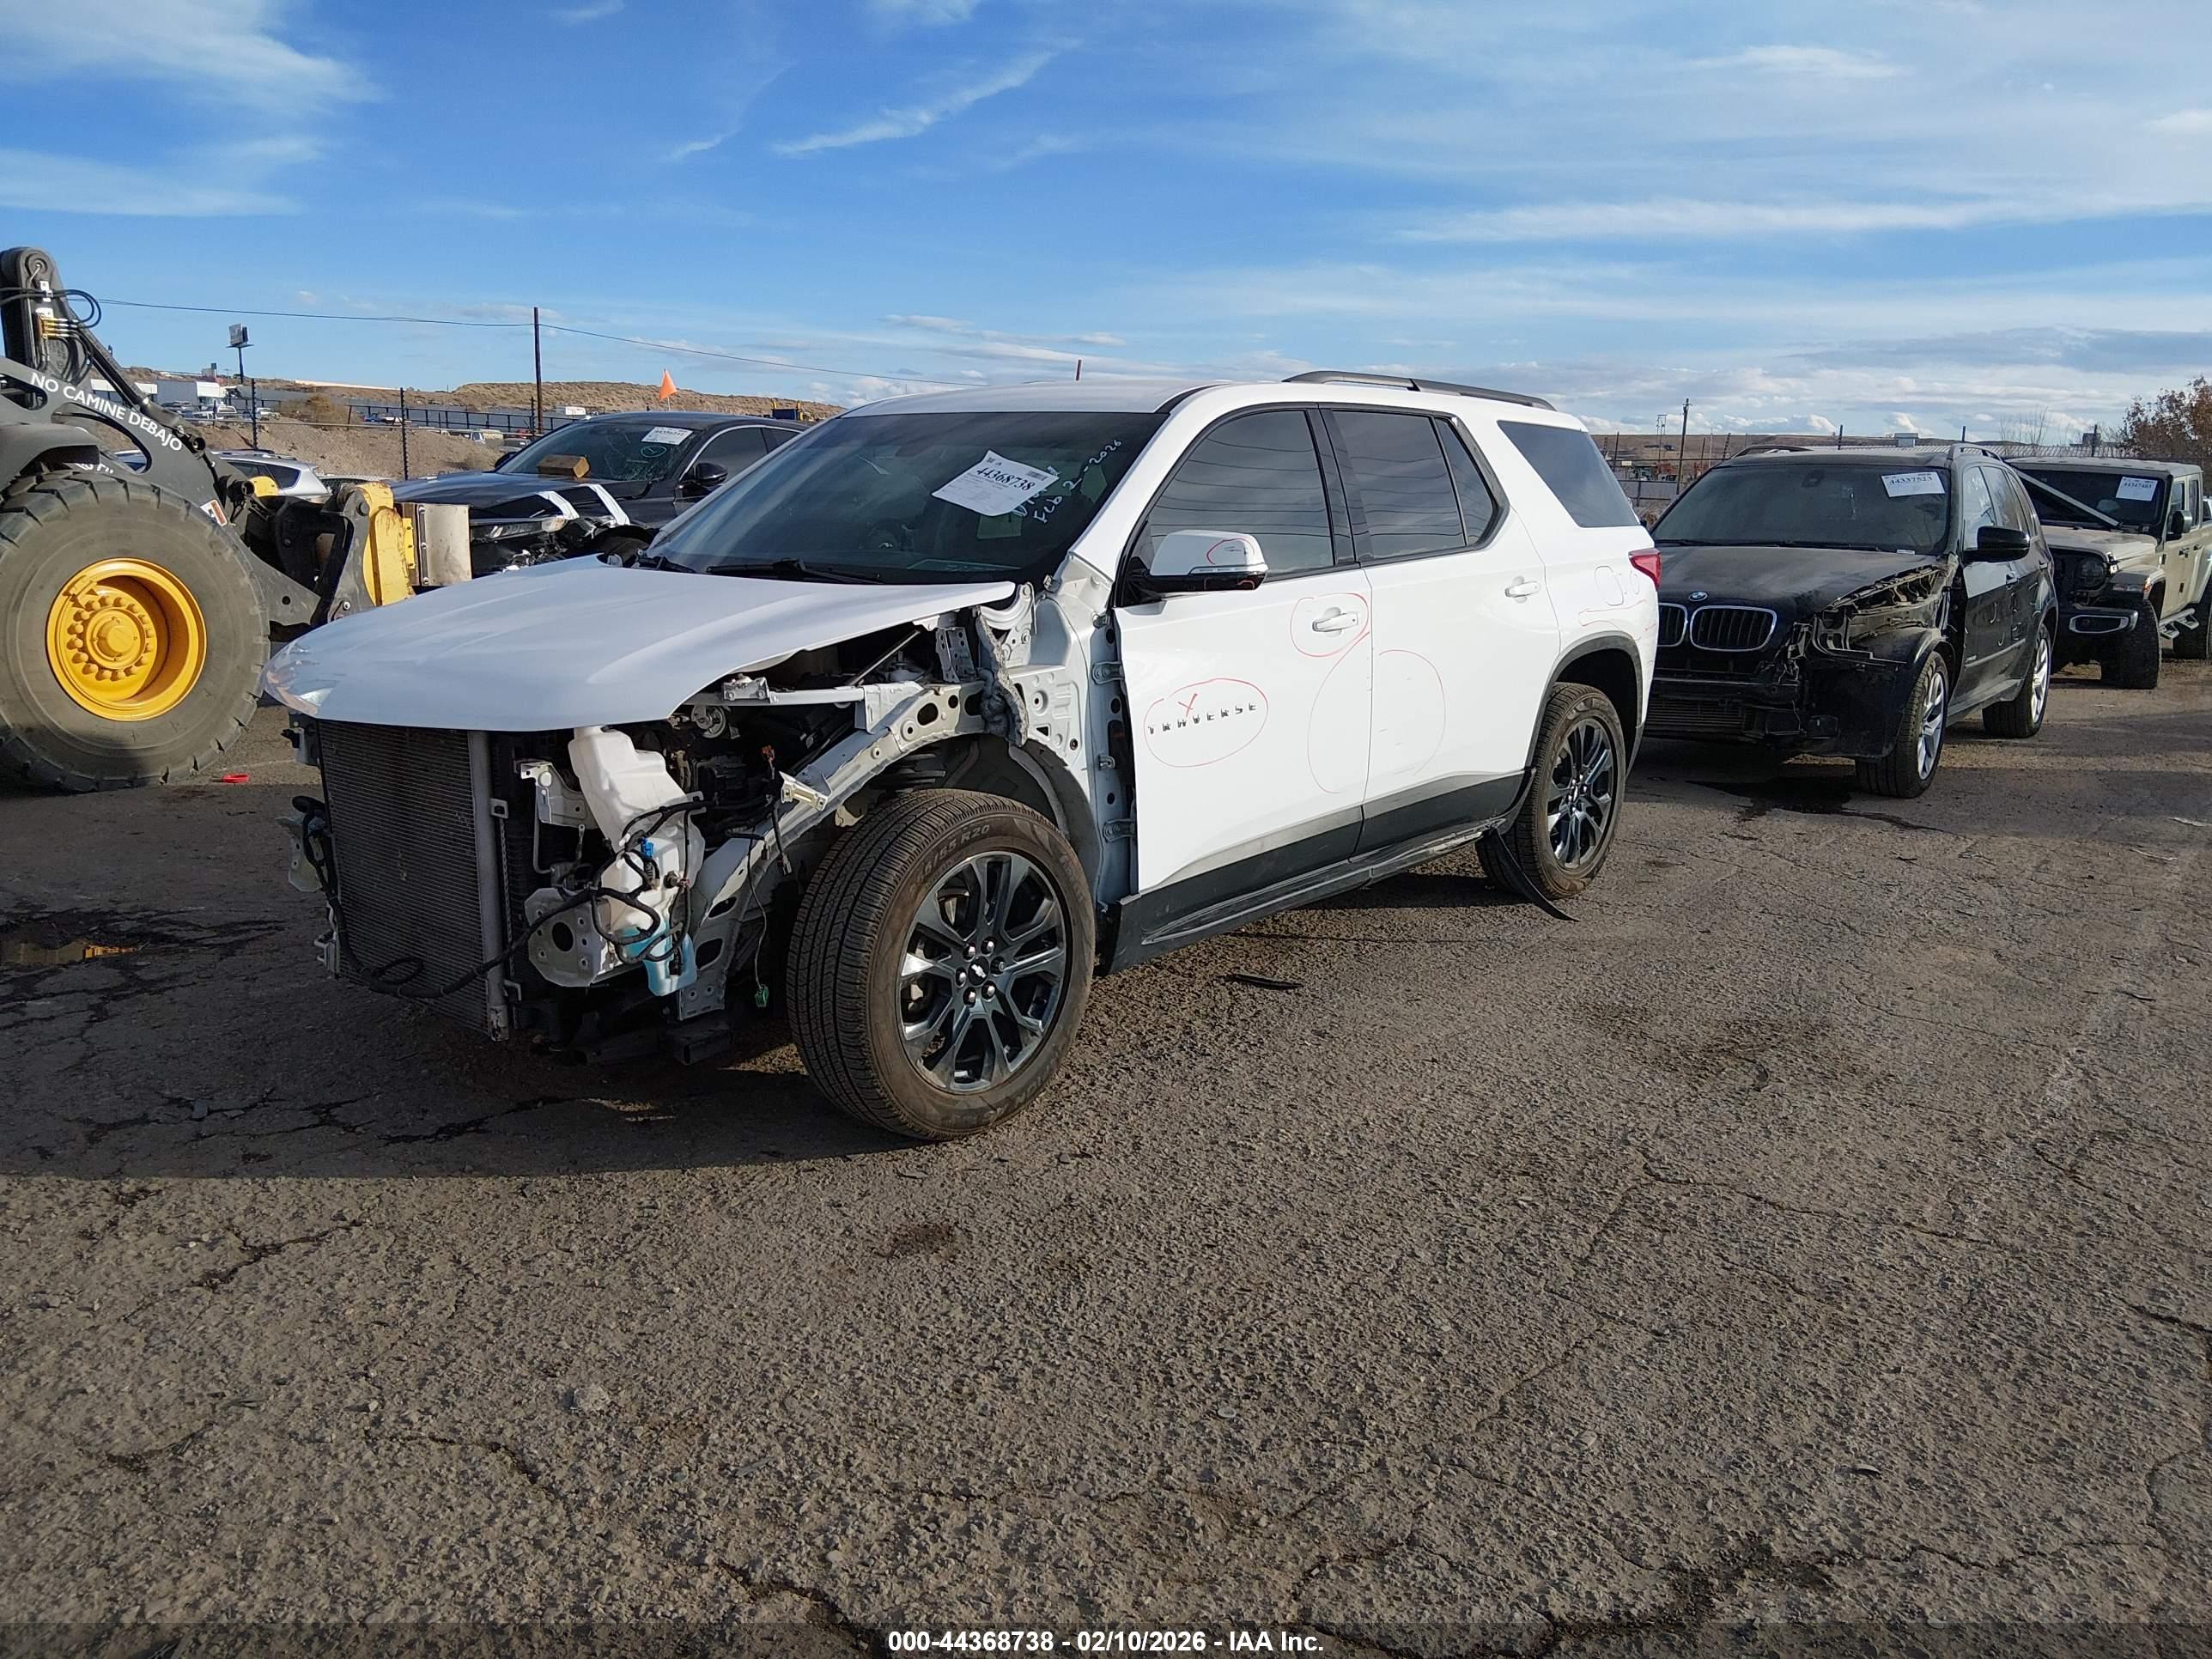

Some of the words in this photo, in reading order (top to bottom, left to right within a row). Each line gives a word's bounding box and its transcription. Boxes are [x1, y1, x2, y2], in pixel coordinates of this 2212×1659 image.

[31, 373, 58, 392] NO
[64, 386, 127, 420] CAMINE
[129, 409, 182, 451] DEBAJO
[976, 466, 1036, 492] 44368738
